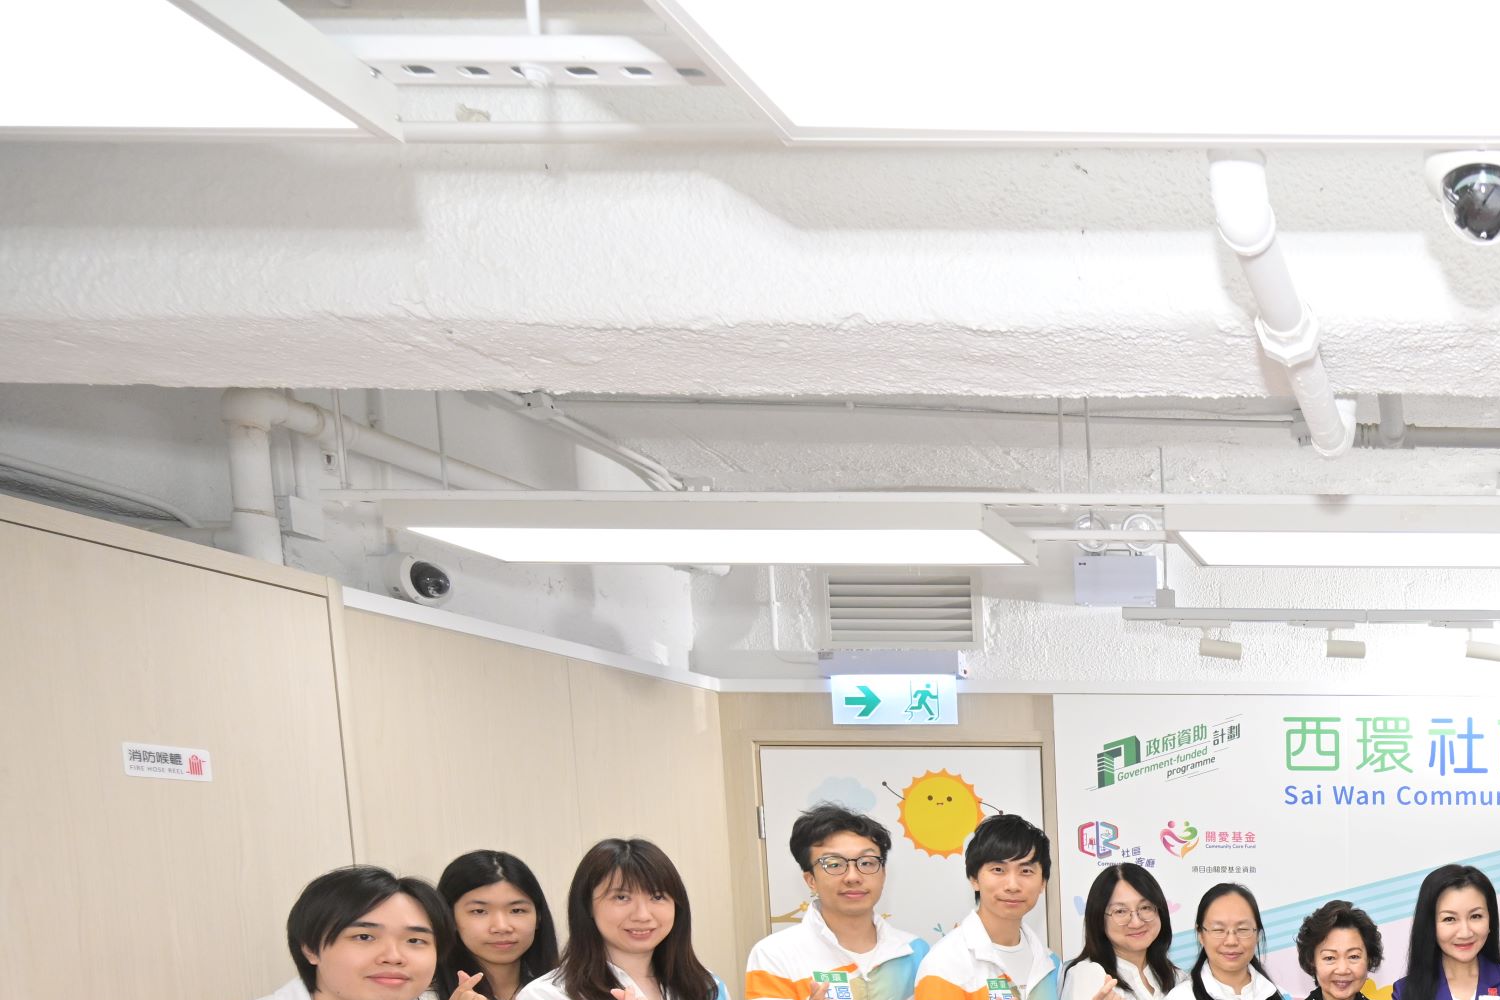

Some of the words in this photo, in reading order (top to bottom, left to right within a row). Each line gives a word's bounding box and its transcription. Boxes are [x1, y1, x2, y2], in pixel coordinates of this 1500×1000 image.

[1145, 723, 1208, 757] 政府資助
[1212, 723, 1241, 746] 計劃
[1117, 746, 1208, 782] Government-funded
[1166, 755, 1216, 778] programme
[1284, 784, 1322, 806] Sai
[1333, 785, 1385, 806] Wan
[1205, 831, 1256, 843] 關愛基金
[1121, 847, 1141, 858] 社區
[1192, 866, 1256, 874] 項目由關愛基金資助
